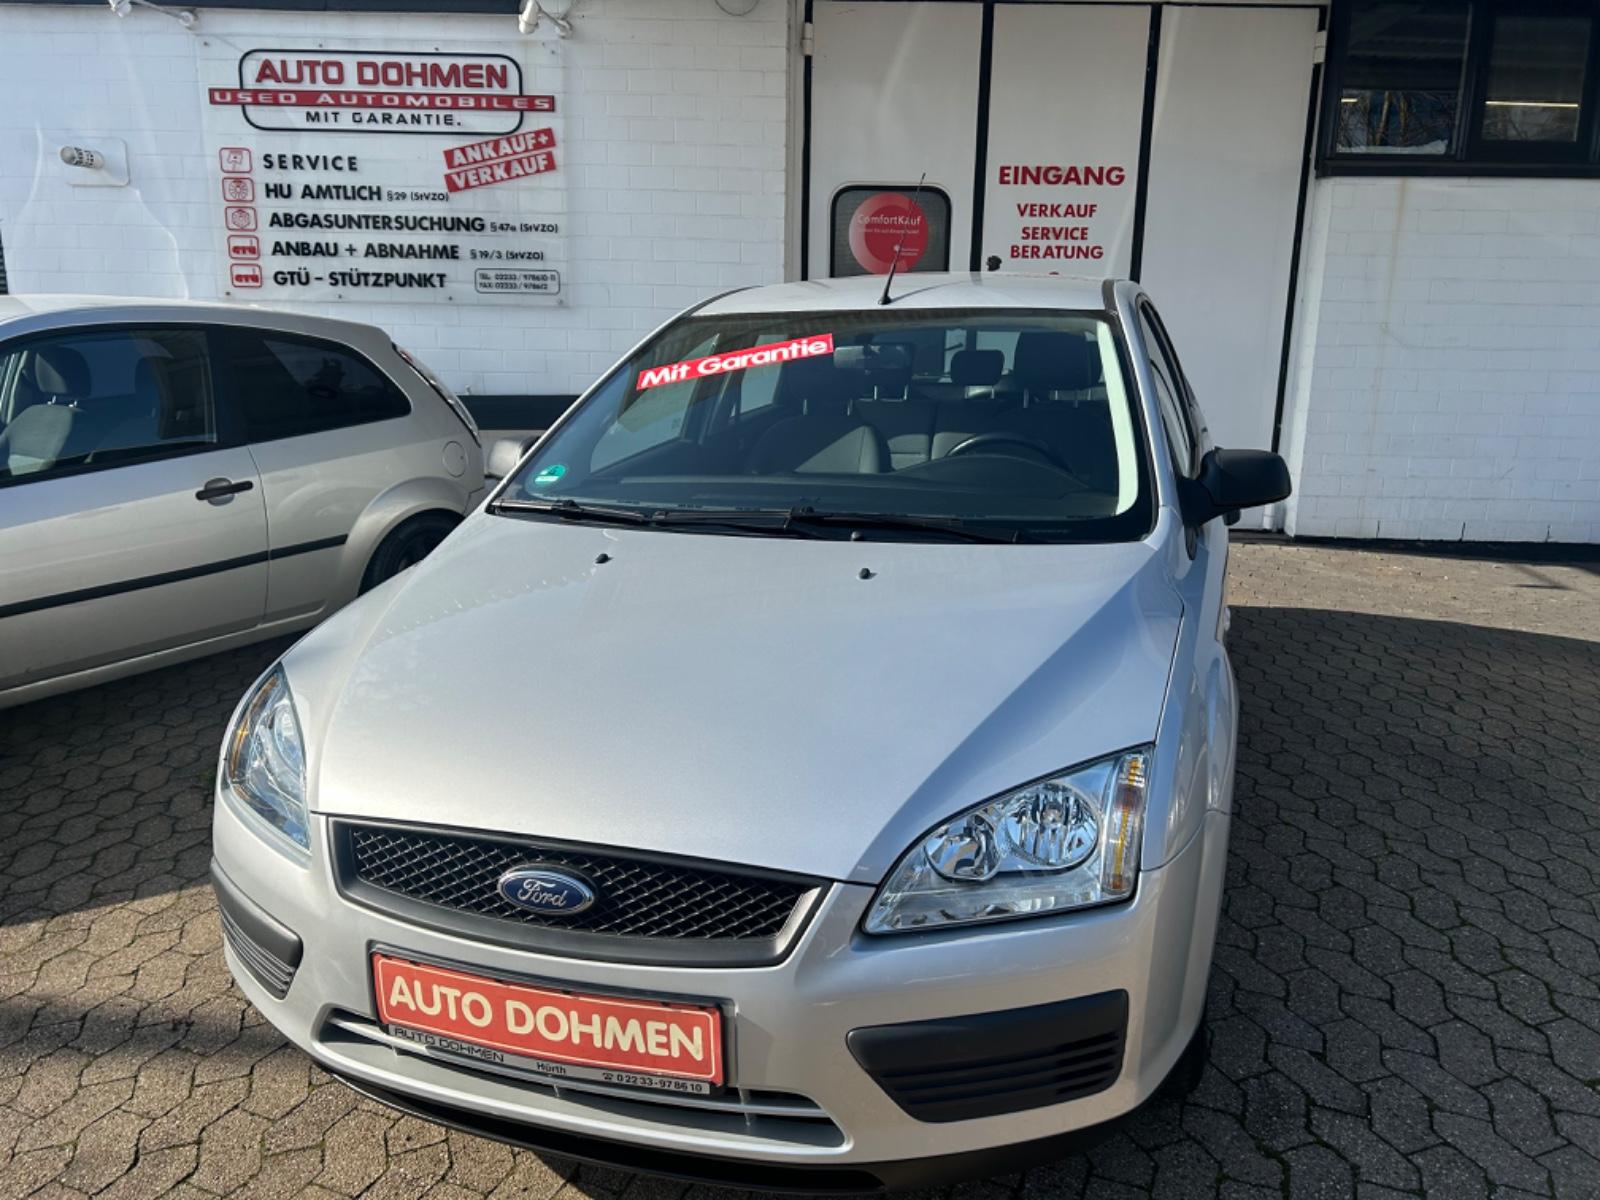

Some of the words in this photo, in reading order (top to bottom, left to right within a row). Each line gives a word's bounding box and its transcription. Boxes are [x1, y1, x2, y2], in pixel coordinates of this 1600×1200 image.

[256, 58, 344, 84] AUTO
[356, 61, 508, 89] DOHMEN
[213, 91, 298, 104] USED
[316, 93, 550, 110] AUTOMOBILES
[305, 111, 340, 124] MIT
[352, 112, 462, 127] GARANTIE.
[262, 153, 358, 172] SERVICE
[451, 155, 549, 189] VERKAUF
[998, 165, 1126, 187] EINGANG
[264, 182, 293, 200] HU
[300, 183, 382, 202] AMTLICH
[1016, 203, 1098, 218] VERKAUF
[268, 211, 486, 233] ABGASUNTERSUCHUNG
[1021, 226, 1089, 241] SERVICE
[270, 240, 339, 258] ANBAU
[344, 245, 358, 256] +
[362, 243, 460, 260] ABNAHME
[1010, 245, 1104, 260] BERATUNG
[272, 267, 311, 287] GTÜ
[328, 268, 447, 289] STÜTZPUNKT
[640, 364, 691, 388] Mit
[697, 338, 828, 375] Garantie
[517, 879, 568, 908] Ford
[389, 975, 493, 1028] AUTO
[505, 999, 704, 1062] DOHMEN
[394, 1027, 436, 1046] AUTO
[439, 1037, 505, 1063] DOHMEN
[536, 1061, 567, 1076] Hürth
